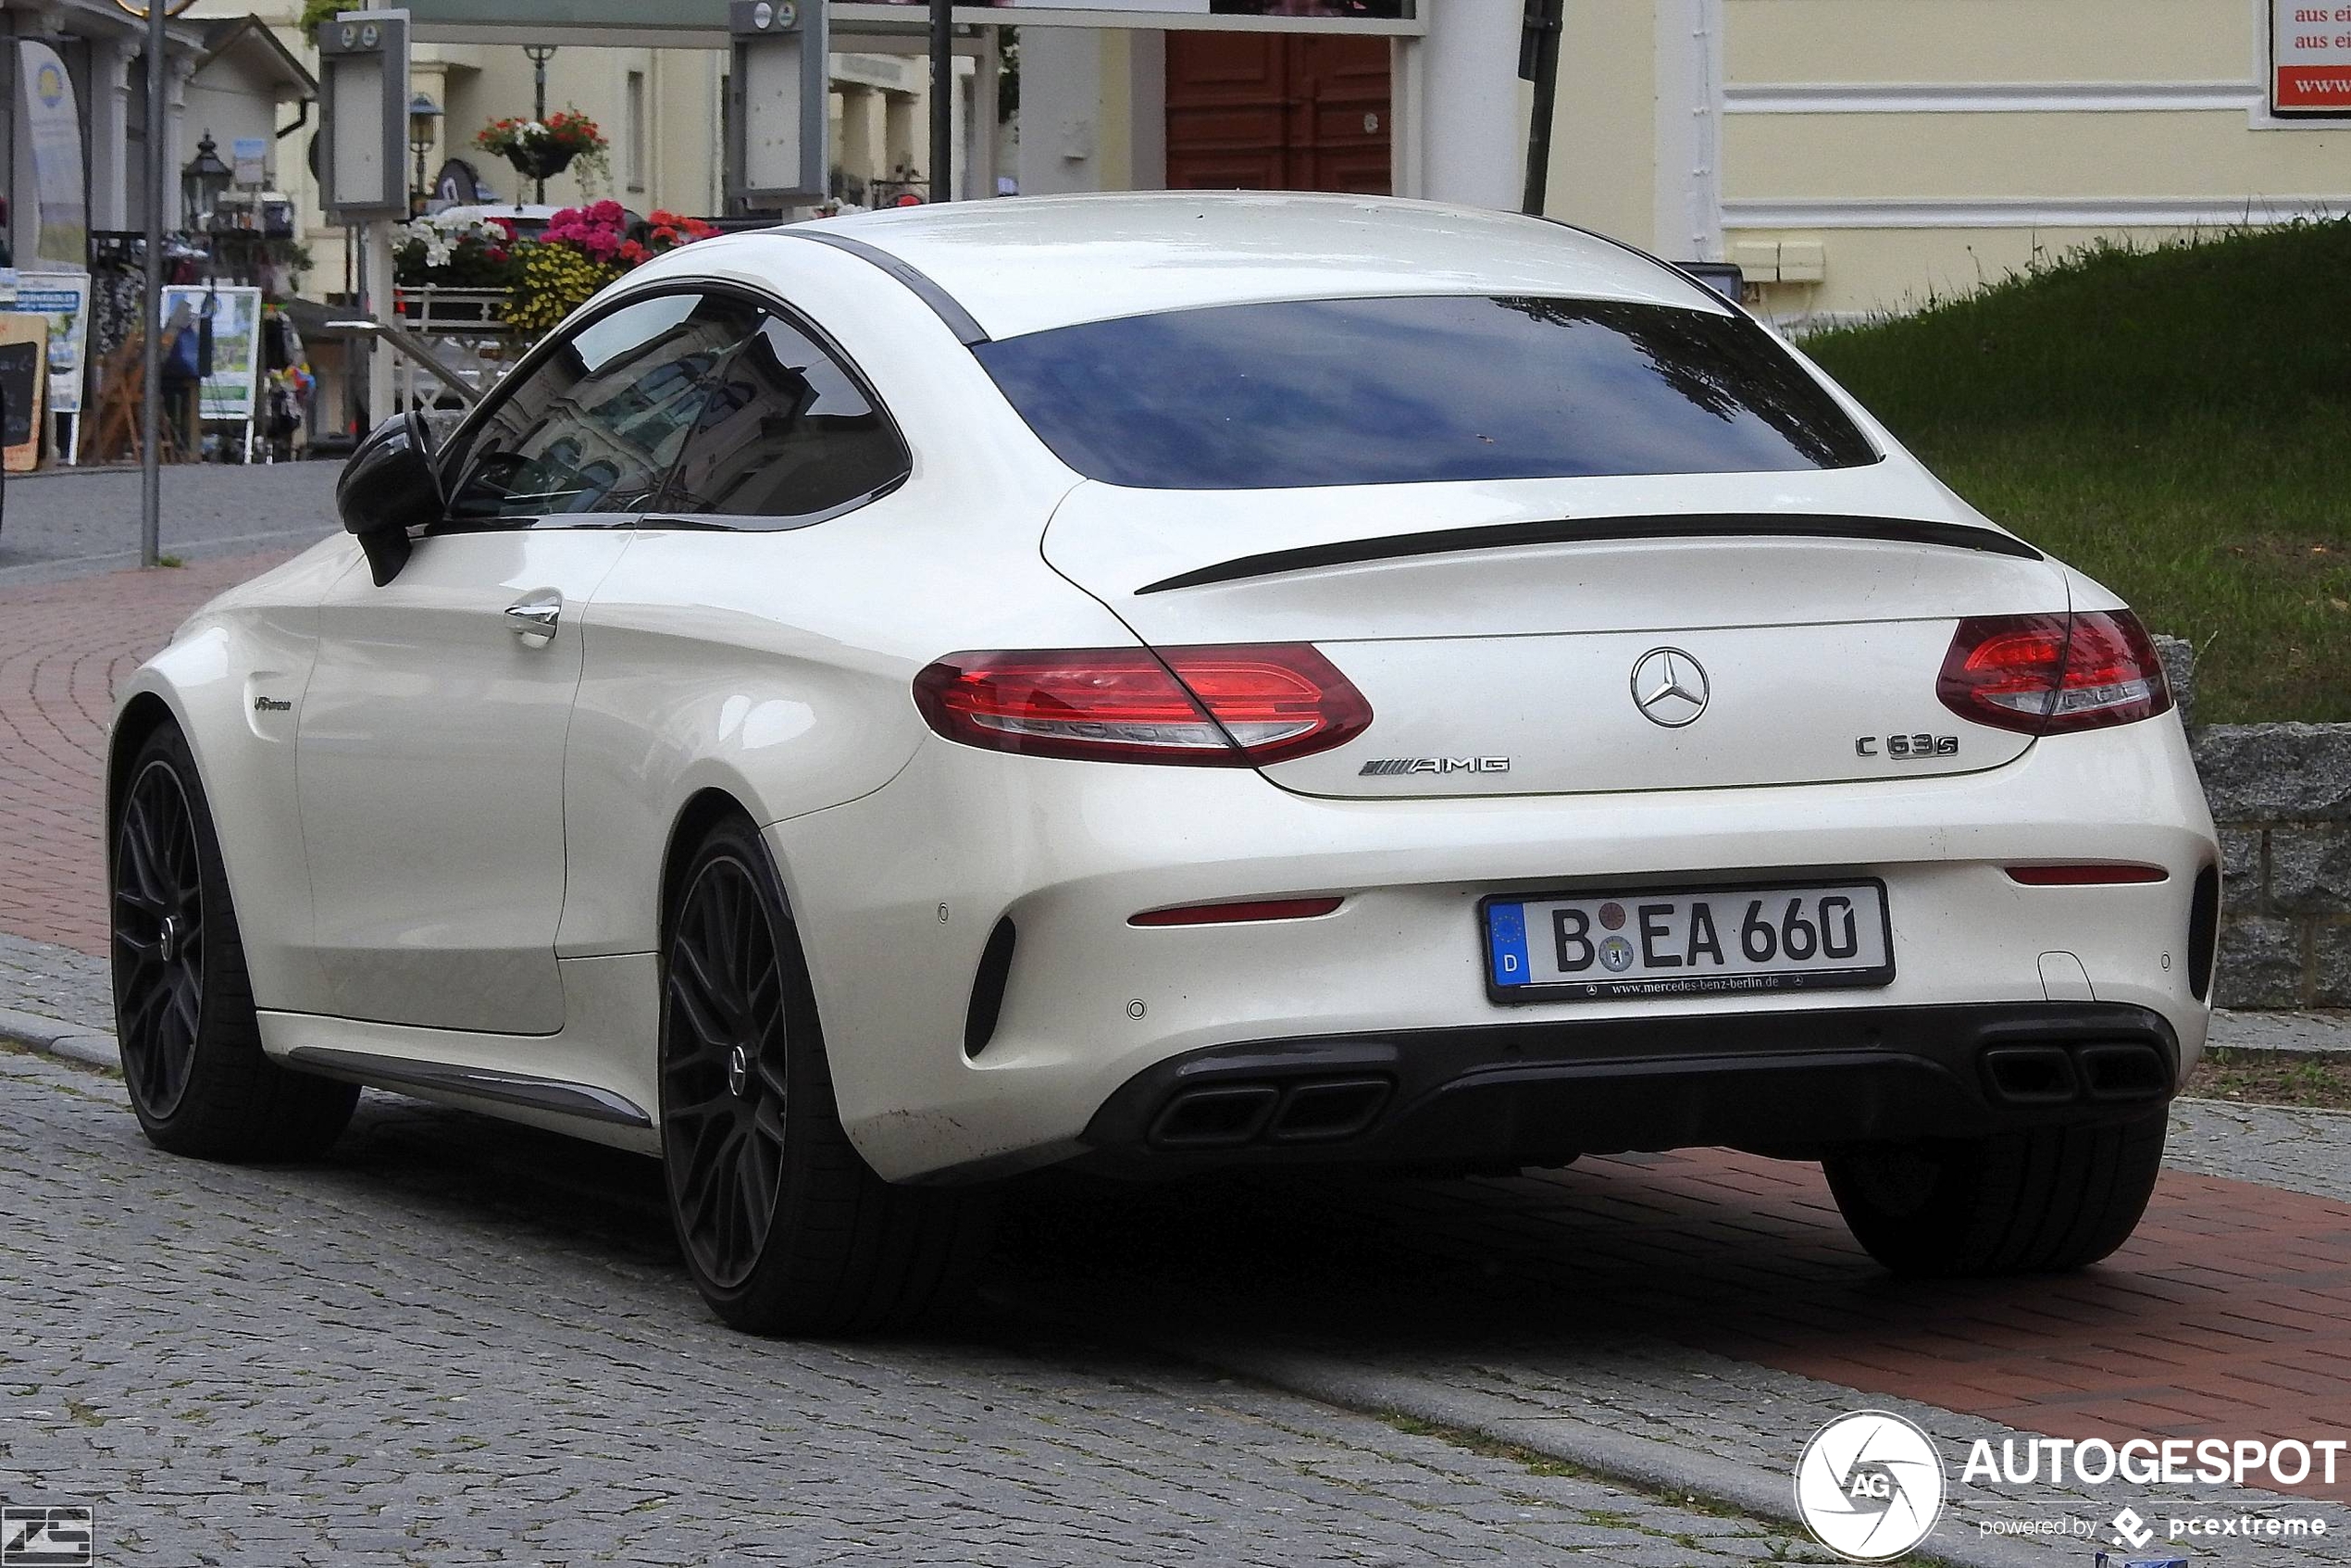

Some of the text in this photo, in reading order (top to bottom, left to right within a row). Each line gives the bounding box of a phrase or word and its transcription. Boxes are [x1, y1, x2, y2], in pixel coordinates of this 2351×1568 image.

[2295, 9, 2328, 22] aus
[2295, 35, 2328, 49] aus
[1856, 737, 1877, 756] C
[1407, 756, 1511, 775] AMG
[1552, 908, 1596, 972] B
[1637, 902, 1725, 968] EA
[1741, 896, 1859, 963] 660
[1504, 954, 1518, 972] D
[1612, 977, 1779, 994] www.mercedes-benz-berlin.de
